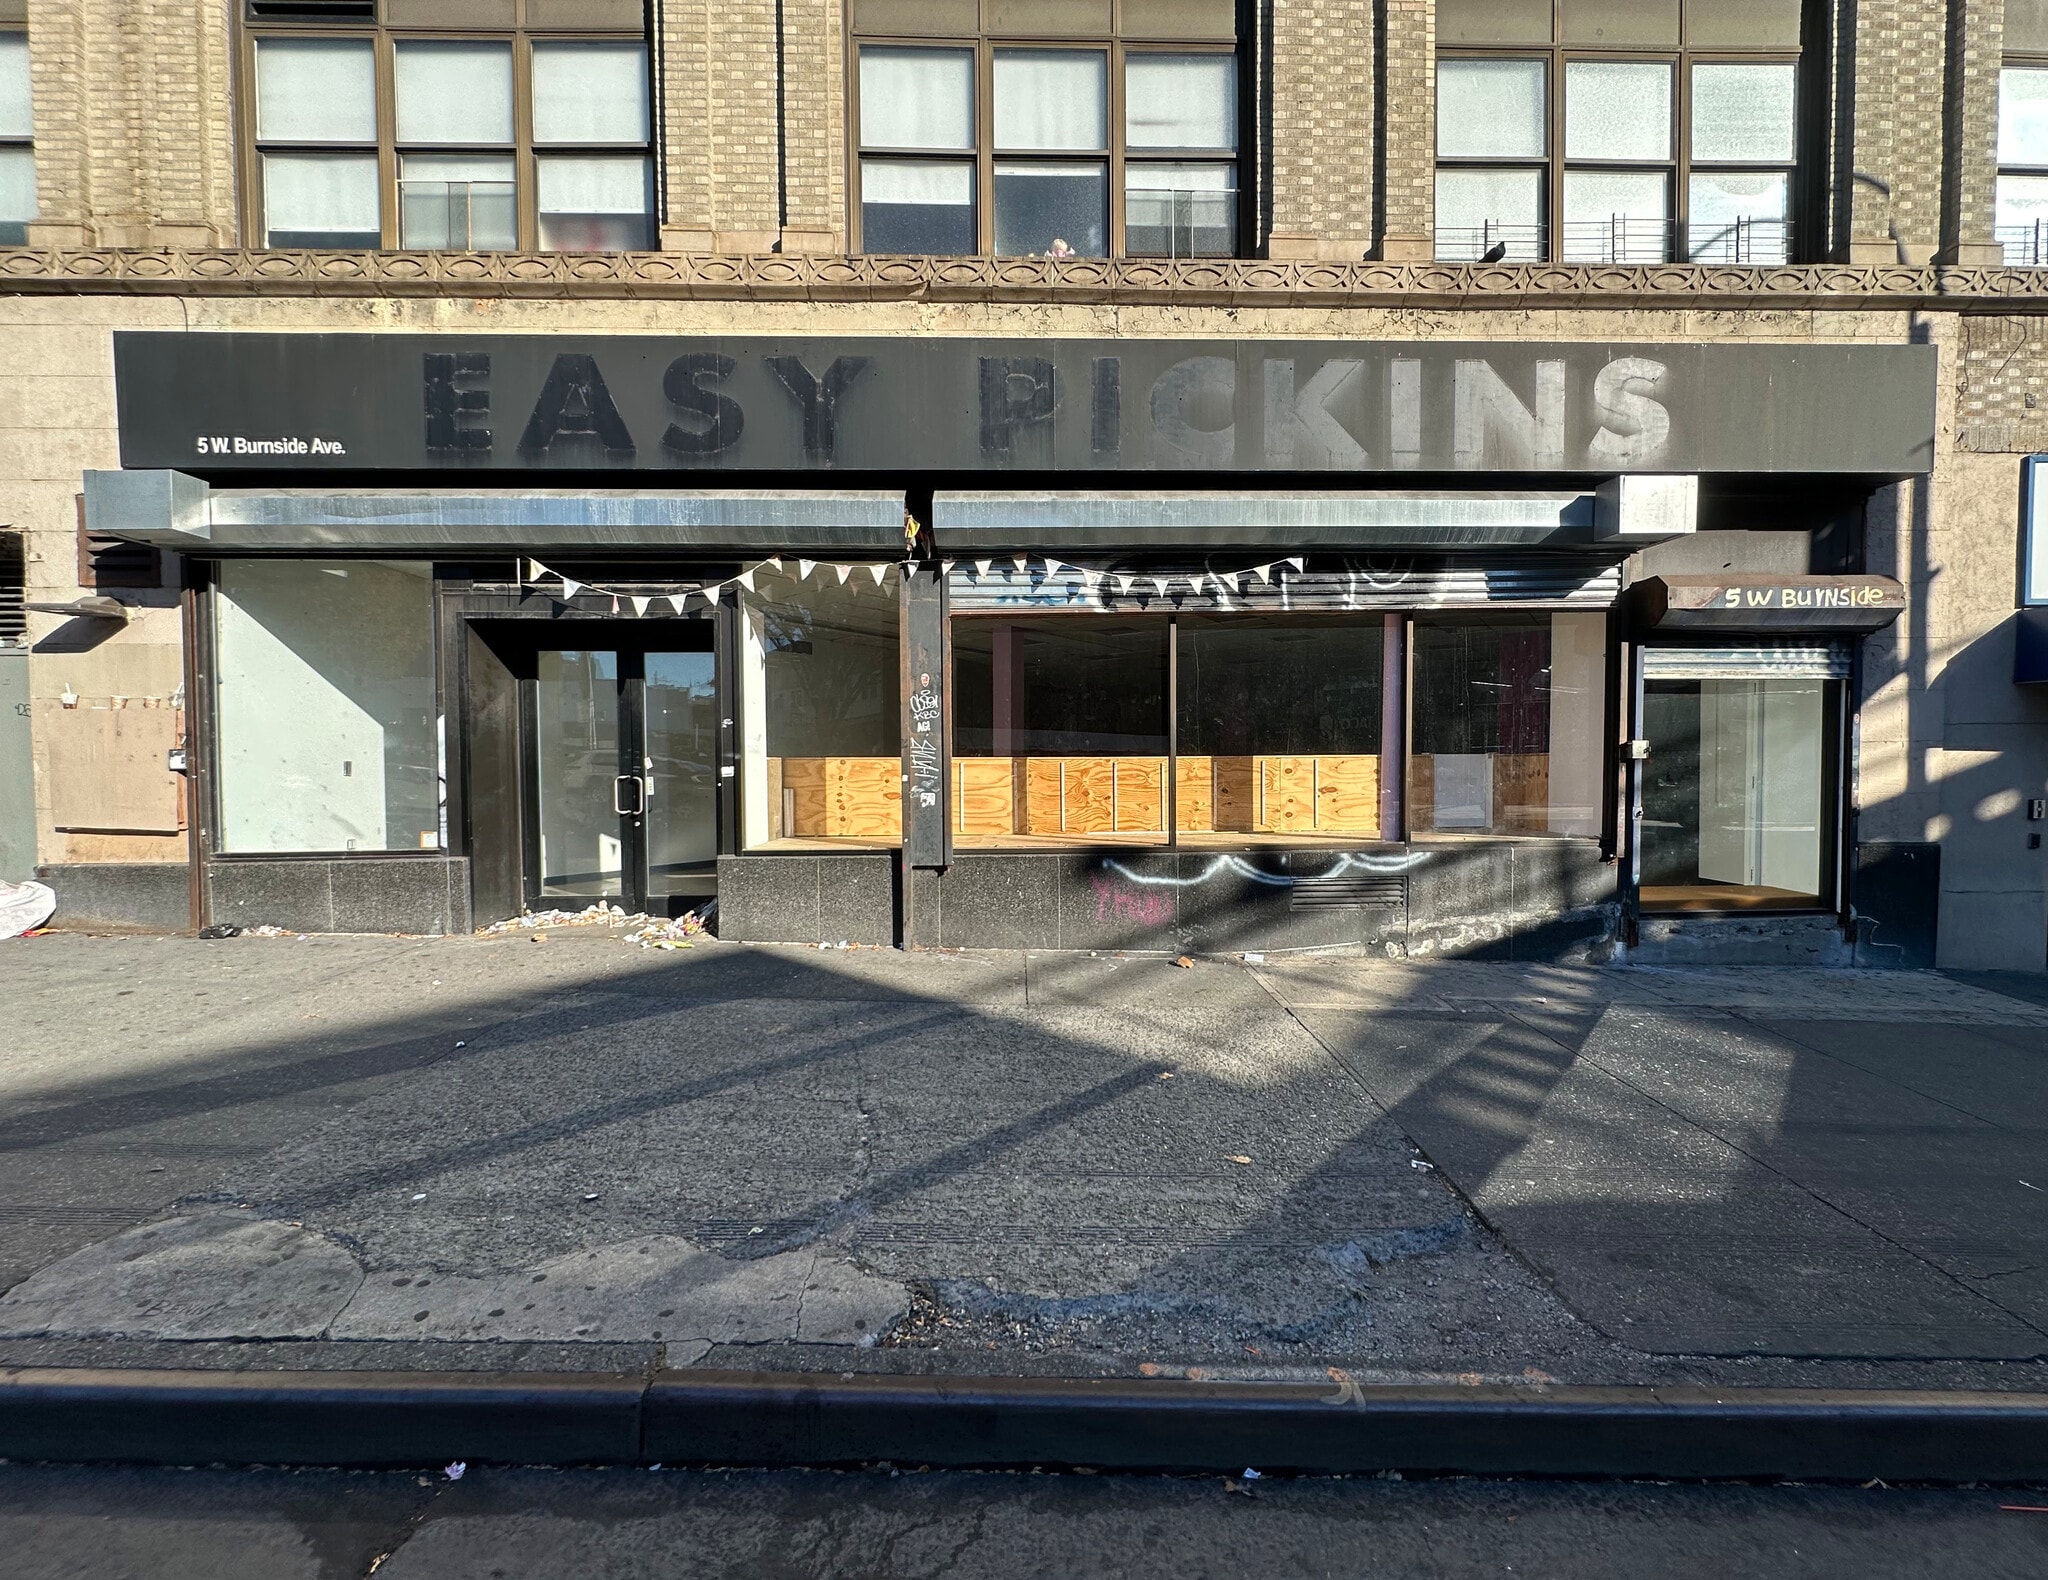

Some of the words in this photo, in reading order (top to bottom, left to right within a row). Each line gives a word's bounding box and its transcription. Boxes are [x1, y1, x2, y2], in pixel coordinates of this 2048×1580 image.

[423, 351, 873, 454] EASY
[978, 355, 1670, 458] PICKINS
[197, 437, 209, 454] 5
[210, 437, 231, 454] W.
[233, 437, 308, 455] Burnside
[311, 437, 346, 455] Ave.
[1725, 588, 1741, 608] 5
[1747, 589, 1773, 607] W
